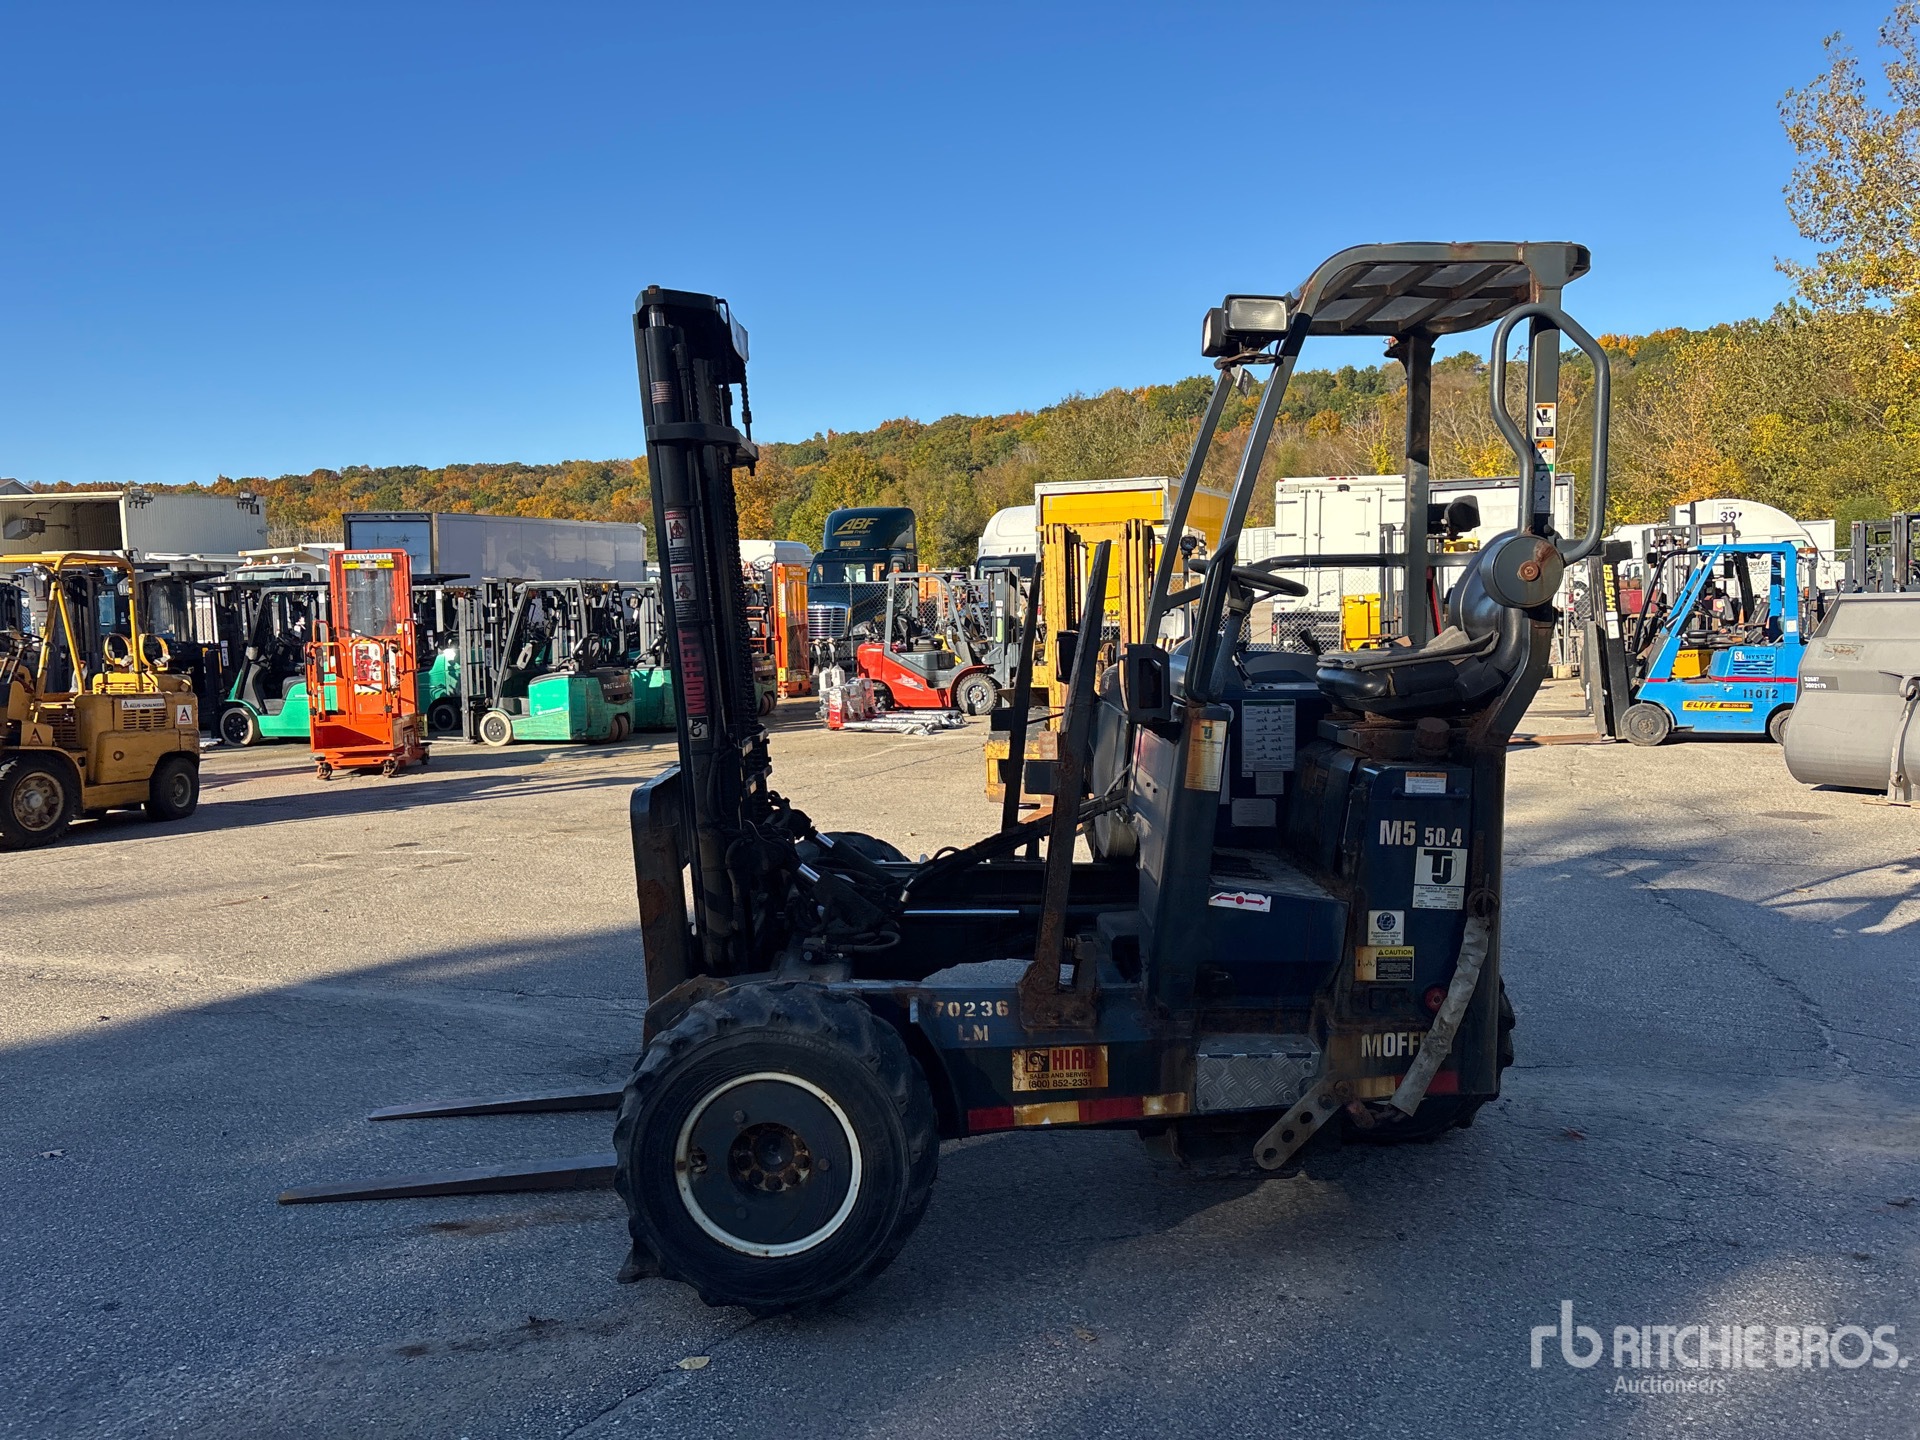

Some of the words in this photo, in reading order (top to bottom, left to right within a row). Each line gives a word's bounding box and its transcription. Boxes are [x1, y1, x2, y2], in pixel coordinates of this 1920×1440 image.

[838, 518, 878, 531] ABF
[1720, 511, 1737, 523] 39
[1603, 564, 1617, 612] HYSTER
[678, 628, 707, 715] MOFFETT
[1743, 689, 1779, 699] 11012
[1379, 820, 1416, 846] M5
[1424, 827, 1462, 847] 50.4
[935, 1000, 1009, 1017] 70236
[958, 1024, 989, 1041] LM
[1361, 1032, 1429, 1057] MOFF
[1052, 1048, 1096, 1071] HIAB
[1028, 1081, 1050, 1089] (800)
[1052, 1078, 1092, 1088] 852-2331
